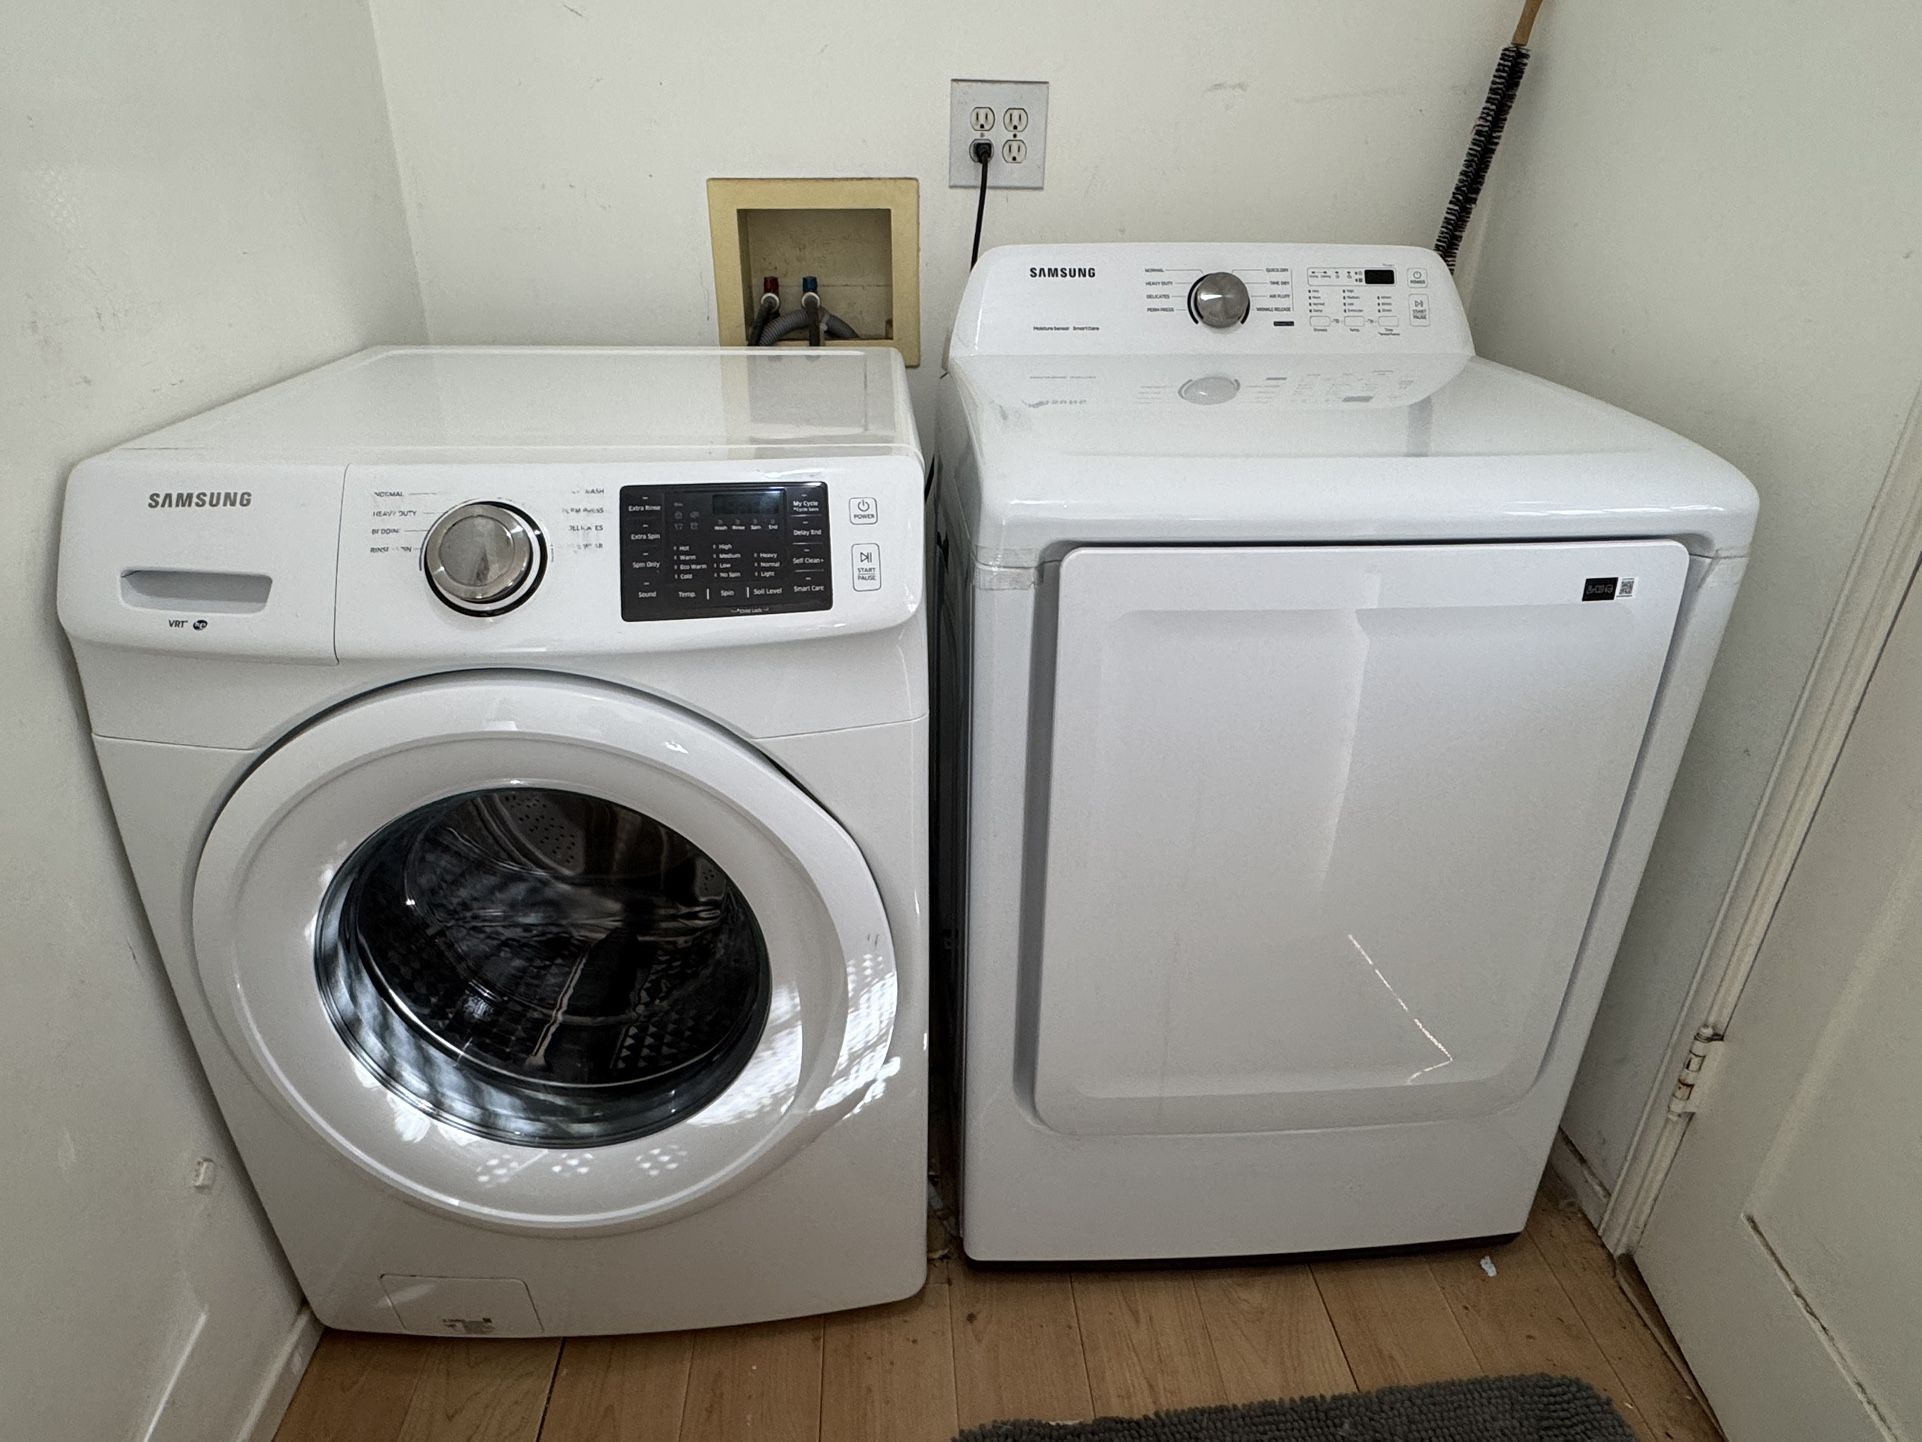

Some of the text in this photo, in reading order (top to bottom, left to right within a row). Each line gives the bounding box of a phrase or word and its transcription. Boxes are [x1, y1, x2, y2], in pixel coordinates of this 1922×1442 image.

[1029, 267, 1096, 278] SAMSUNG
[148, 491, 252, 508] SAMSUNG
[766, 587, 783, 595] Level
